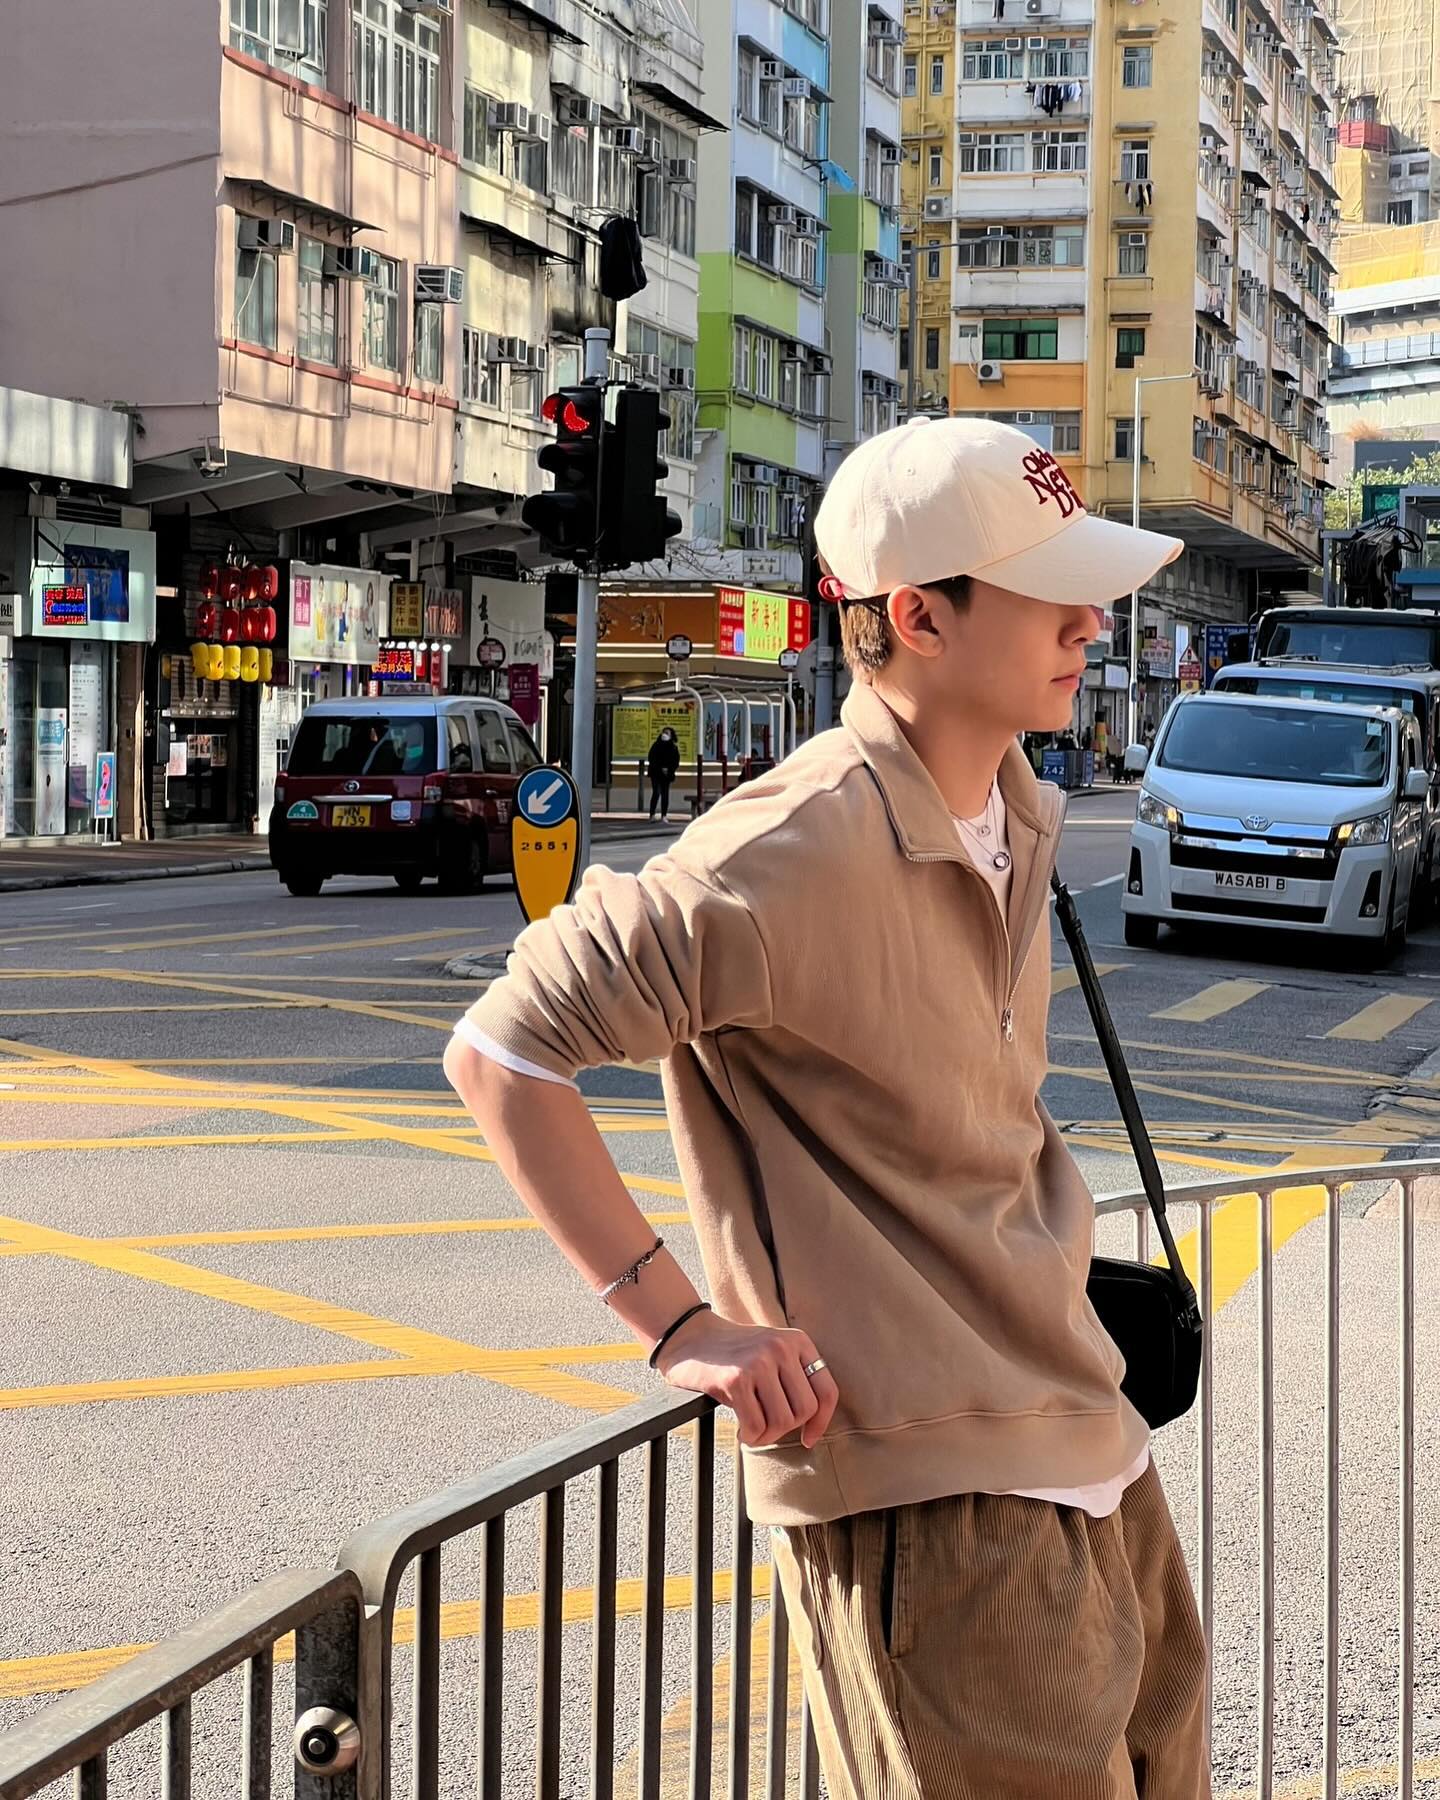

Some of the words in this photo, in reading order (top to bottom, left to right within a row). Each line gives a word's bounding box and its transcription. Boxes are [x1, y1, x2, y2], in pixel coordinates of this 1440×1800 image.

[337, 815, 366, 826] 7139
[1215, 872, 1269, 889] WASABI
[1276, 878, 1286, 890] B
